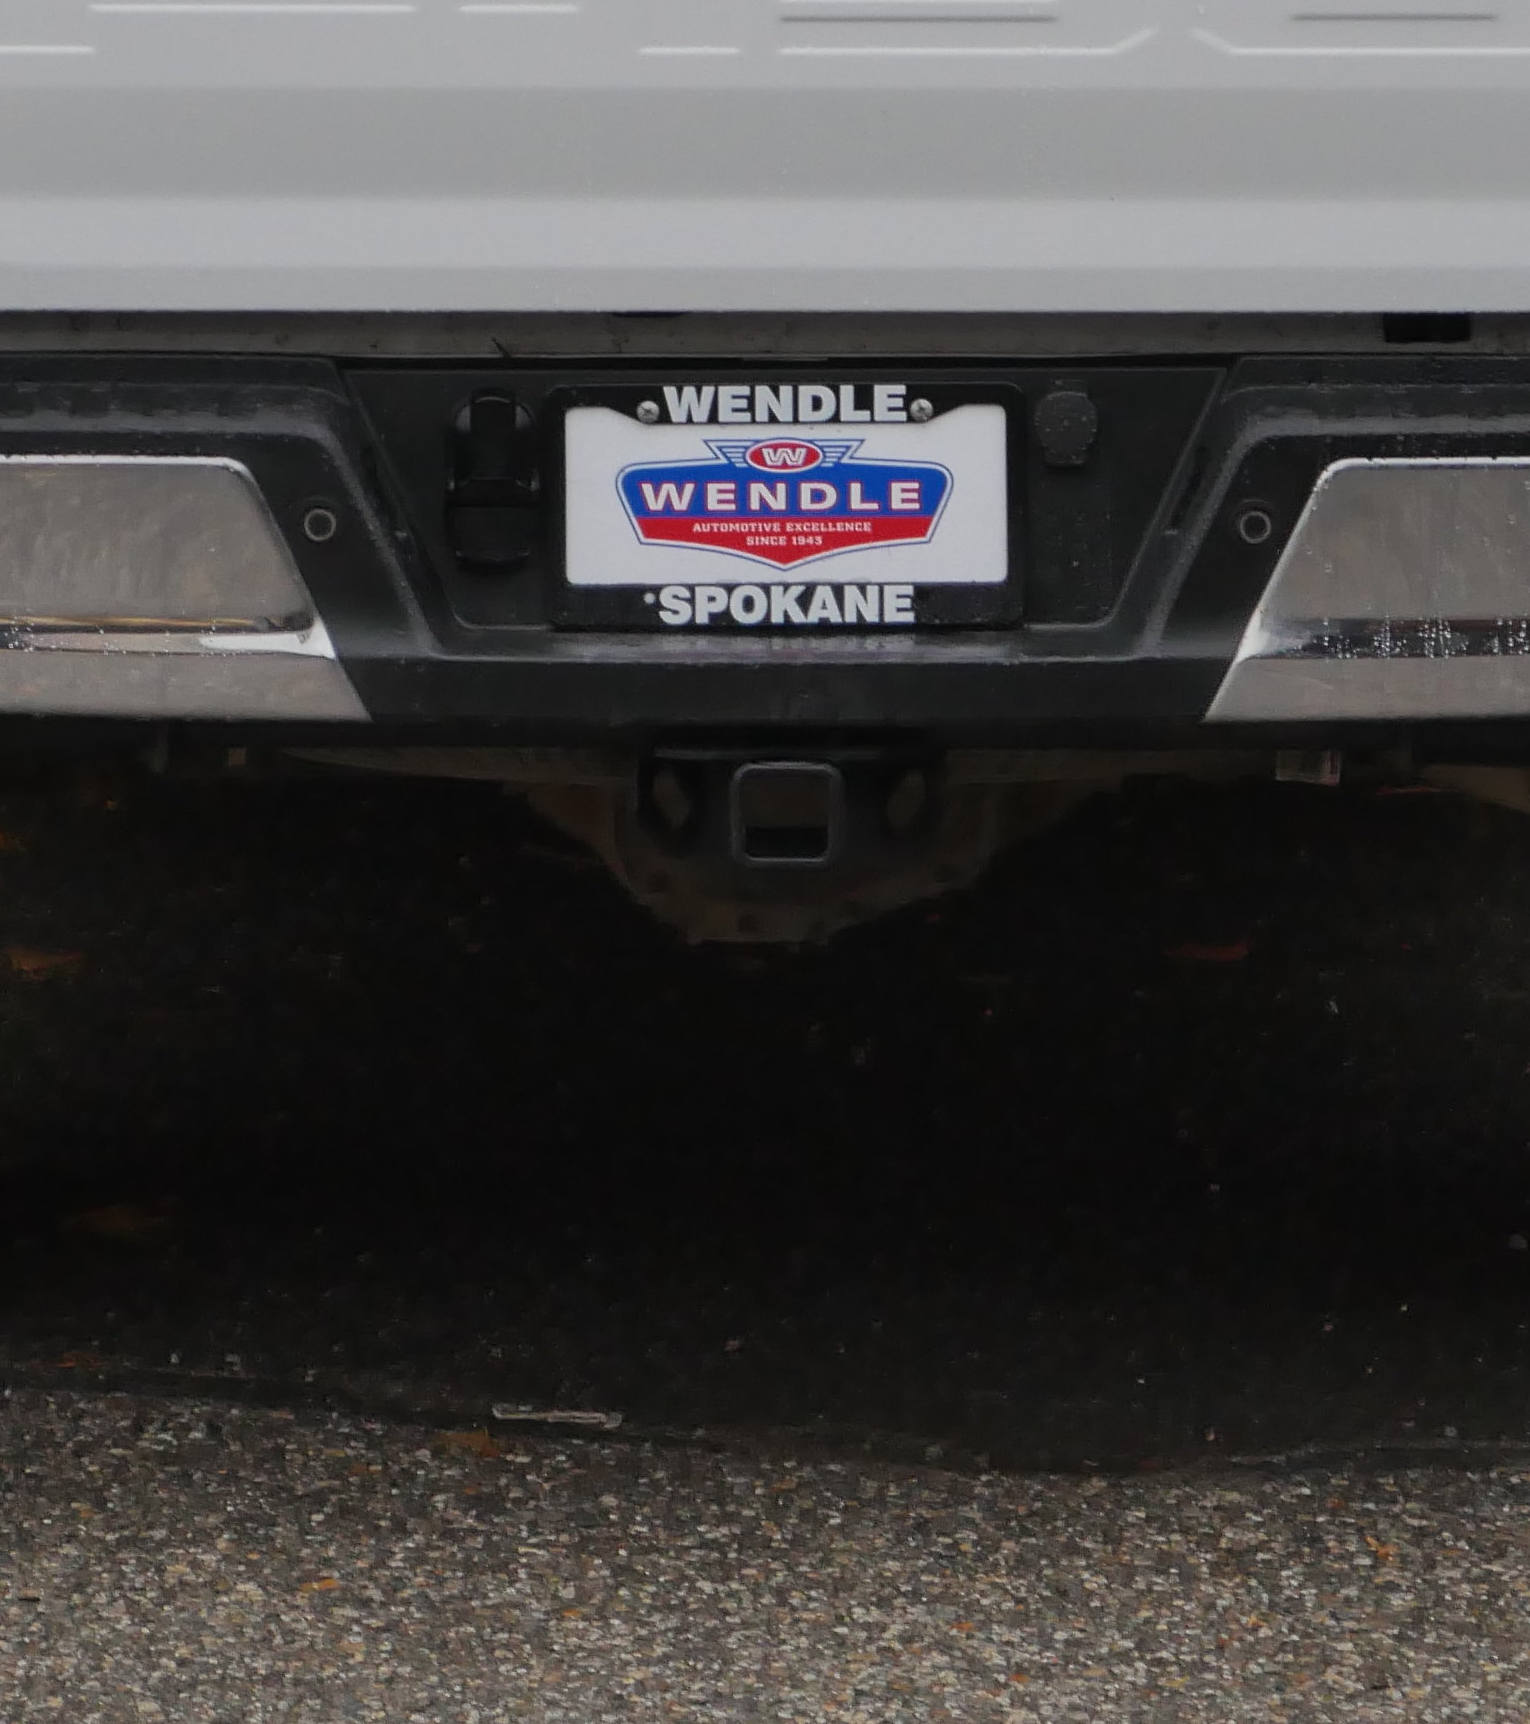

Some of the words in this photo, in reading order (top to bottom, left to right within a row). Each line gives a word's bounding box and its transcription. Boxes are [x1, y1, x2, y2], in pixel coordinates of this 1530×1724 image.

[662, 384, 908, 424] WENDLE
[640, 482, 921, 512] WENDLE
[692, 522, 782, 533] AUTOMOTIVE
[785, 522, 872, 533] EXCELLENCE
[745, 536, 788, 546] SINCE
[658, 584, 915, 625] SPOKANE
